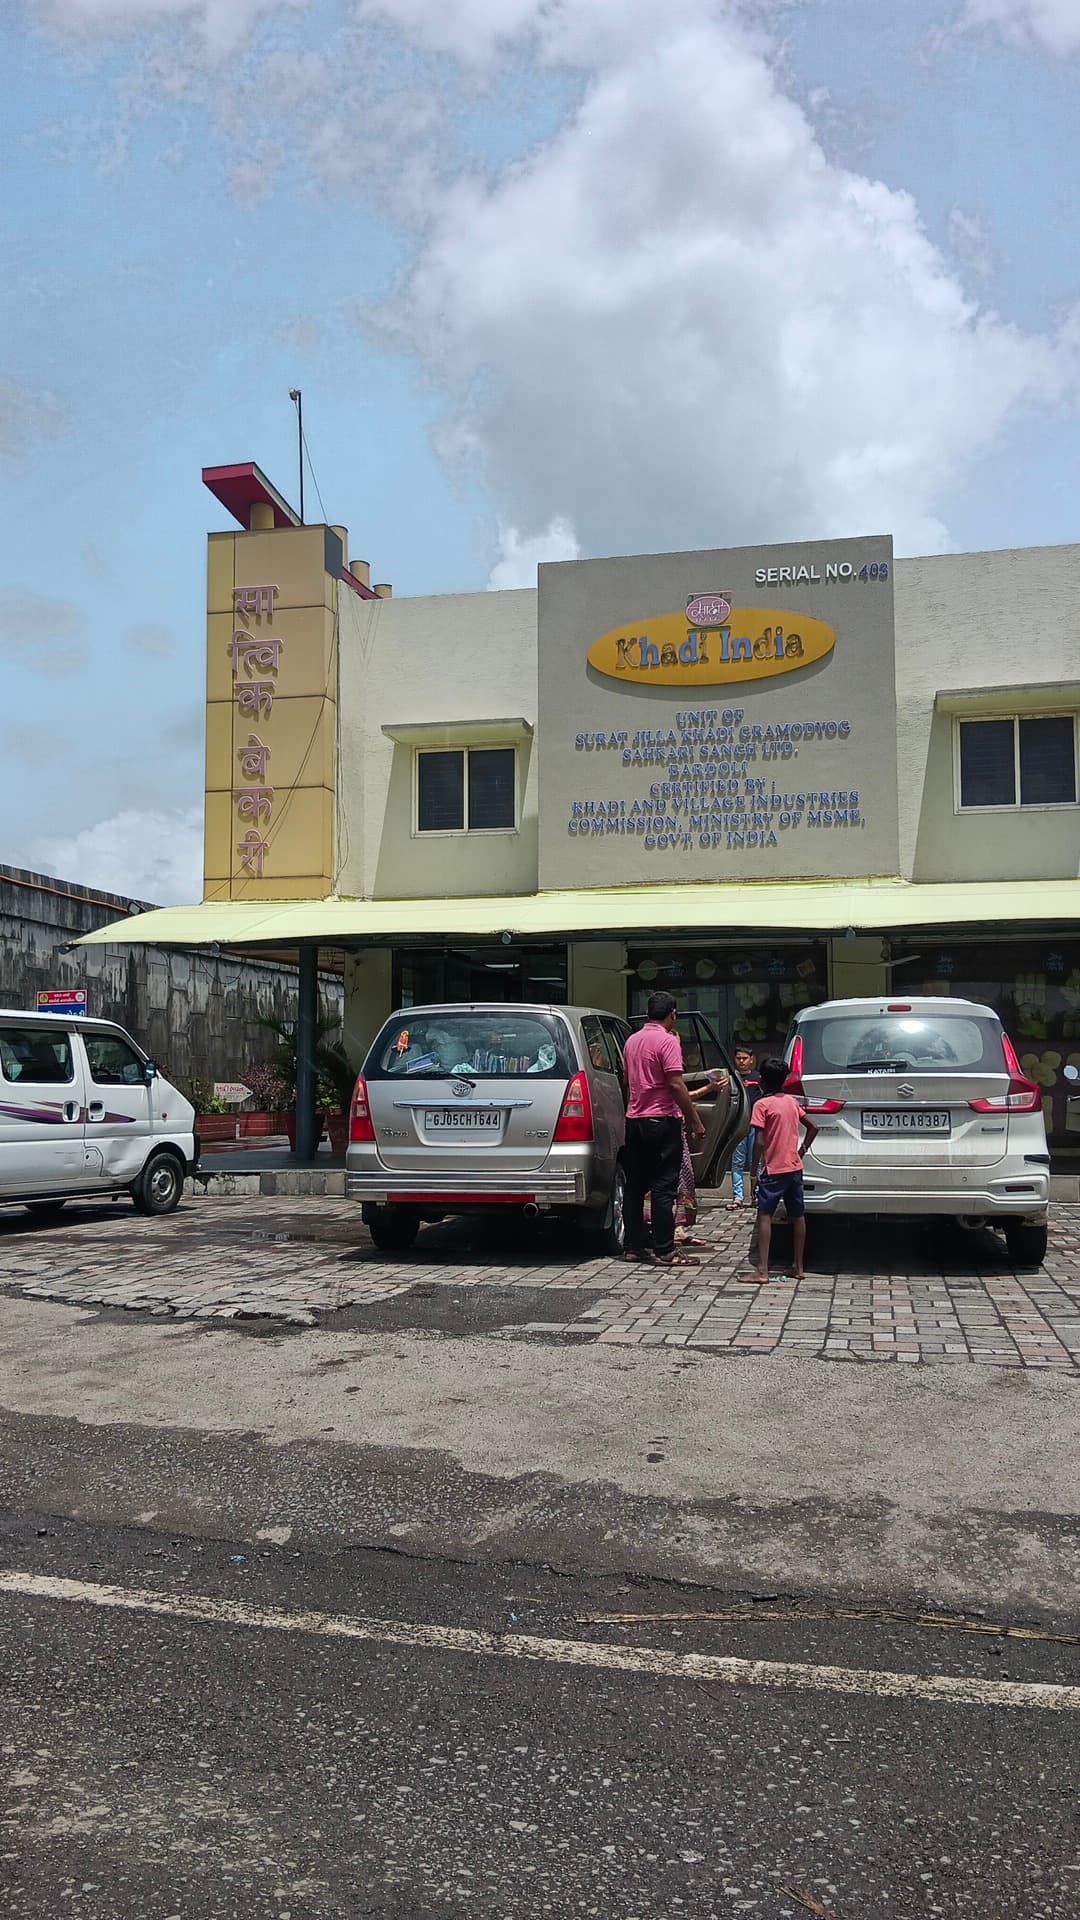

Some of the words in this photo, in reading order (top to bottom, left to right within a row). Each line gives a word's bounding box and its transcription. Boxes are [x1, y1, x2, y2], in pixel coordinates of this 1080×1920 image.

[755, 565, 821, 583] SERIAL
[825, 562, 858, 578] NO.
[859, 561, 889, 578] 403
[615, 629, 710, 669] Khadi
[719, 625, 805, 664] India
[675, 711, 718, 727] UNIT
[721, 708, 745, 723] OF
[575, 731, 629, 745] SURAT
[635, 729, 677, 744] JILLA
[680, 726, 735, 742] KHADI
[622, 746, 695, 762] SAHKARI
[668, 760, 749, 776] BARDOLI
[649, 779, 739, 795] CERTIFIED
[744, 777, 767, 791] BY
[572, 800, 626, 815] KHADI
[632, 799, 668, 812] AND
[672, 795, 745, 811] VILLAGE
[750, 790, 860, 807] INDUSTRIES
[689, 812, 773, 828] MINISTRY
[779, 810, 803, 825] OF
[699, 830, 723, 845] OF
[727, 829, 778, 843] INDIA
[433, 1113, 499, 1127] GJ05CH1644
[871, 1111, 948, 1128] GJ21CA8387
